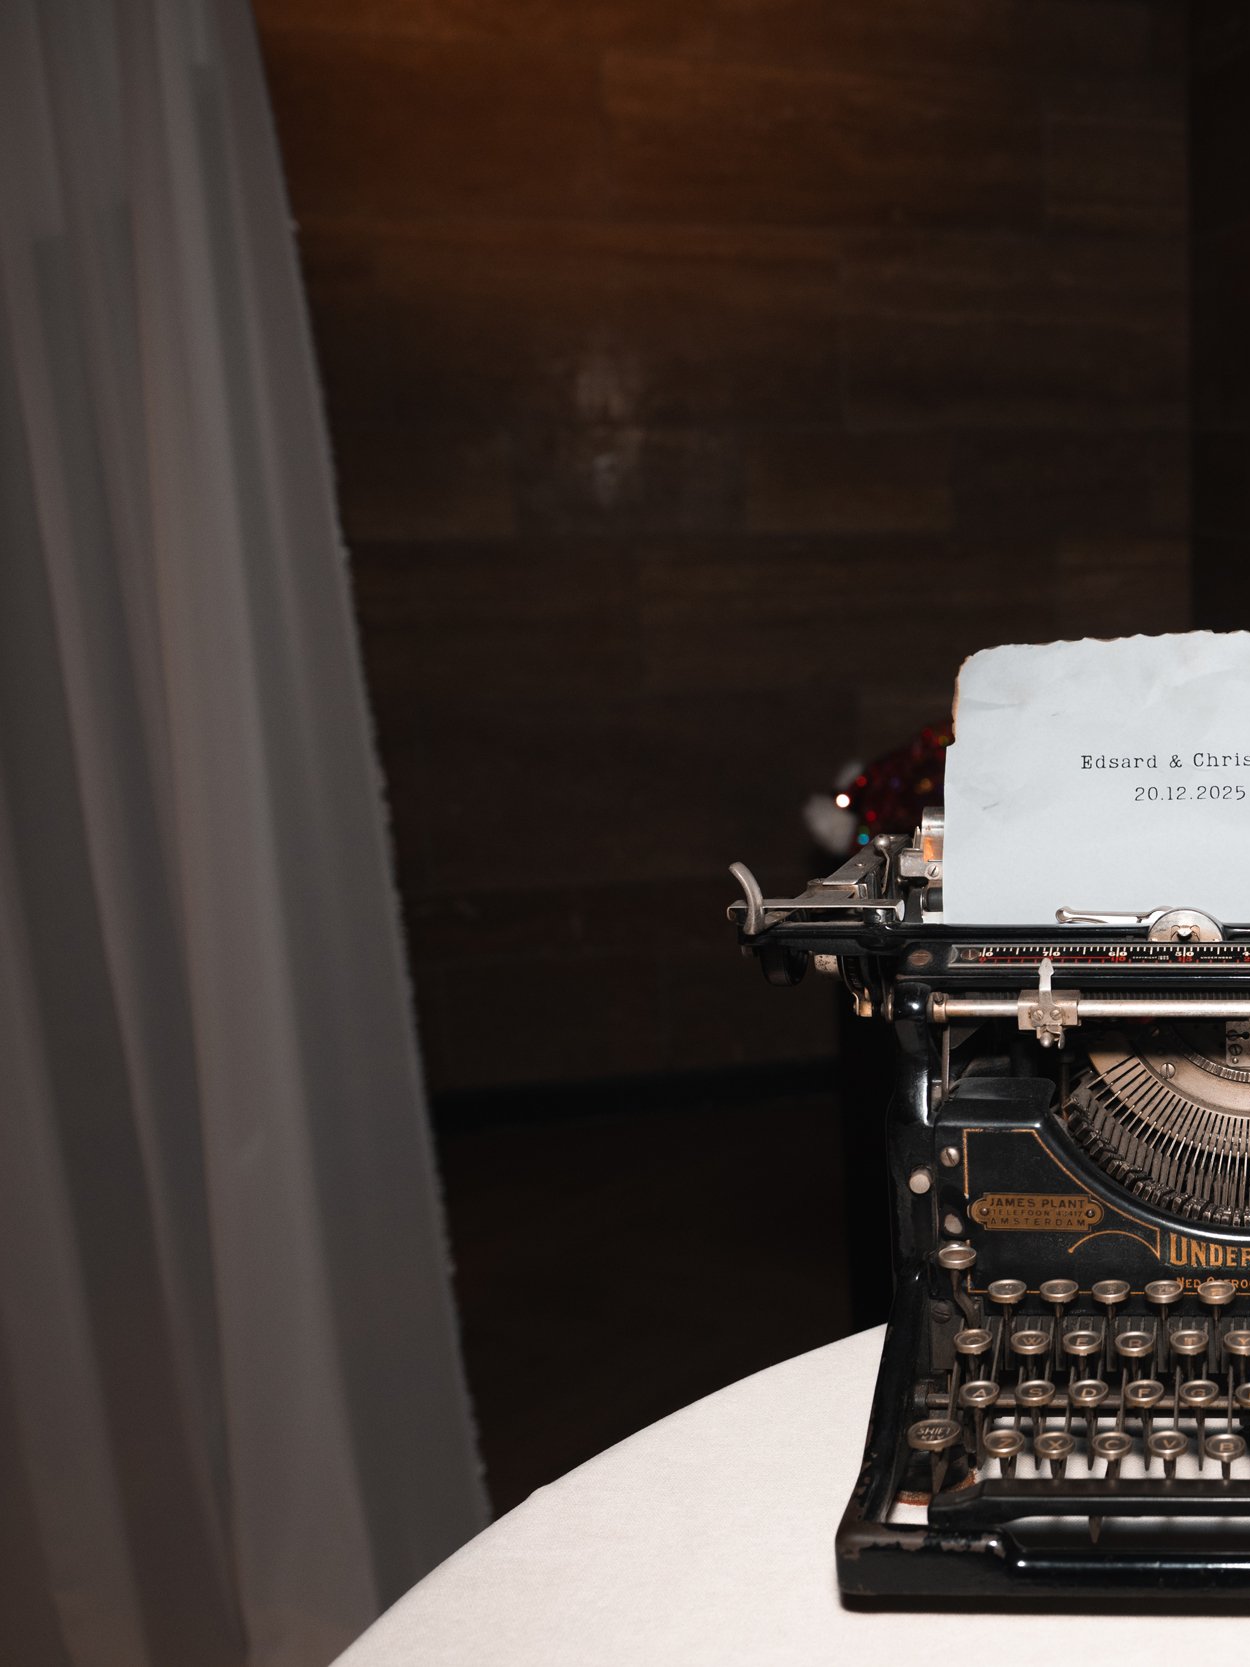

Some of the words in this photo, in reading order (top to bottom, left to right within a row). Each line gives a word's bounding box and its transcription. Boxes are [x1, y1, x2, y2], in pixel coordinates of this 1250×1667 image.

[1080, 754, 1158, 770] Edsard
[1169, 754, 1183, 769] &
[1134, 785, 1247, 802] 20.12.2025
[989, 1198, 1036, 1208] JAMES
[1041, 1199, 1086, 1209] PLANT
[991, 1208, 1050, 1217] TELEFOON
[990, 1217, 1086, 1226] AMSTERDAM
